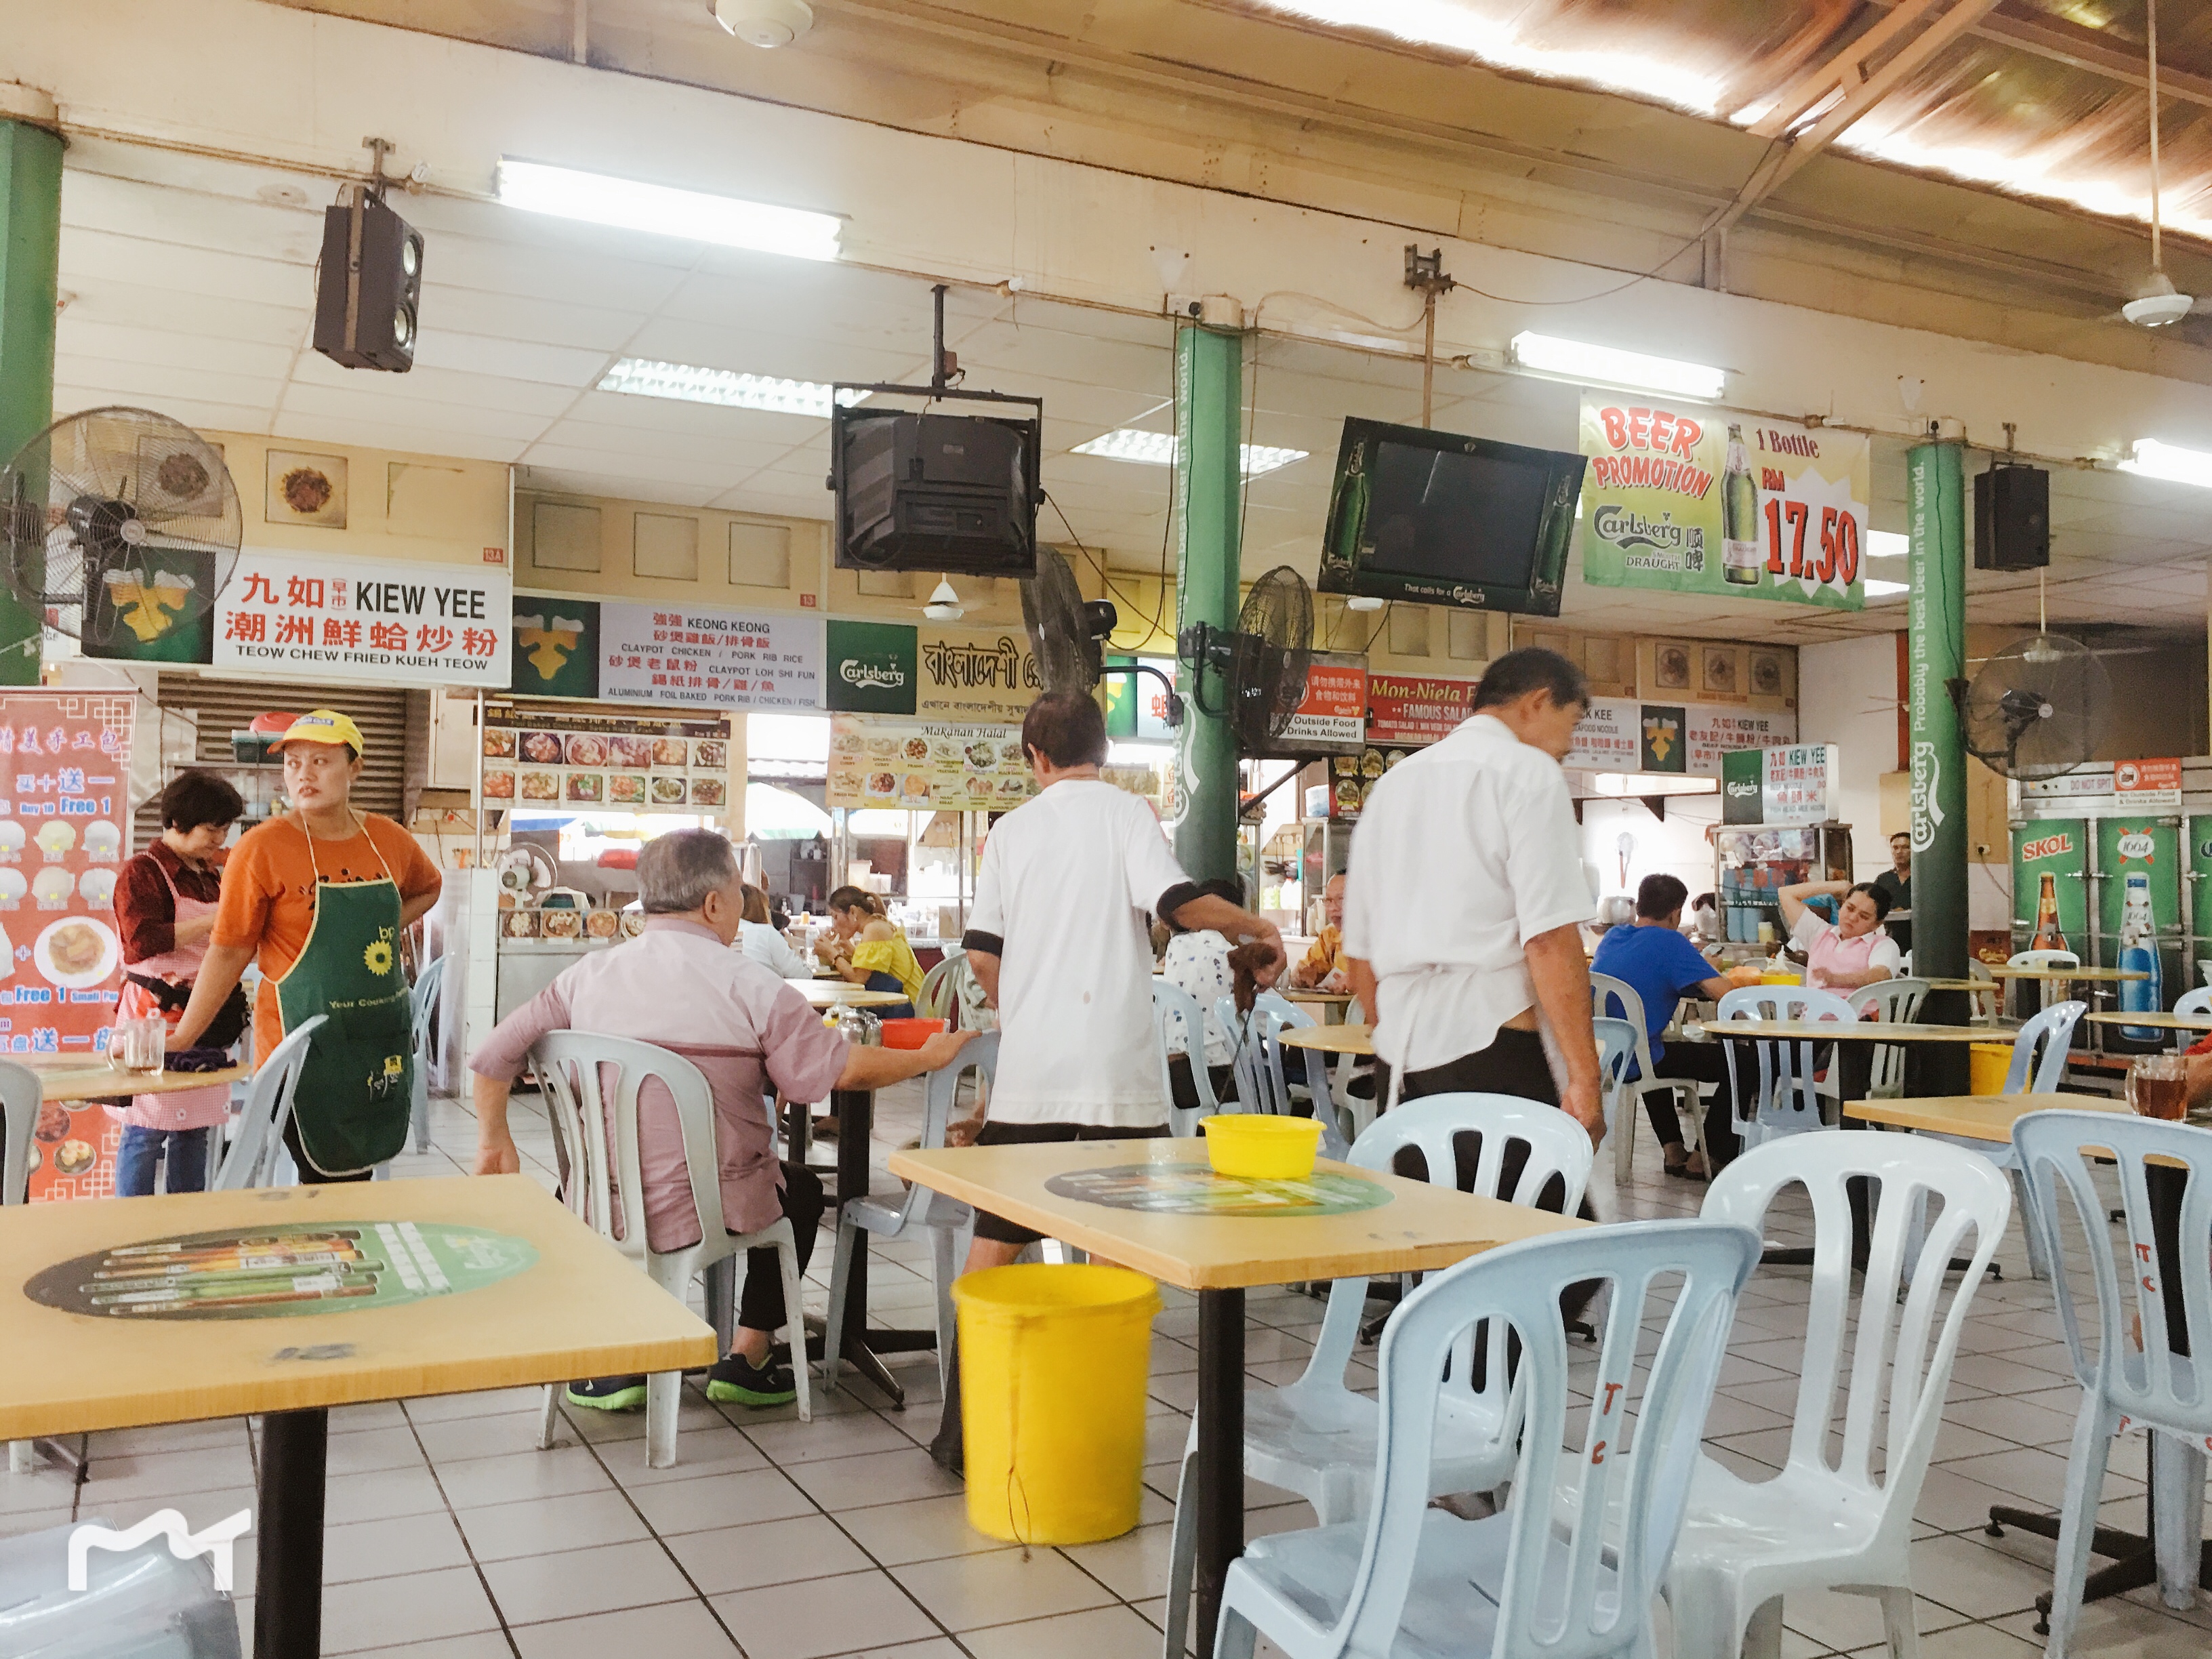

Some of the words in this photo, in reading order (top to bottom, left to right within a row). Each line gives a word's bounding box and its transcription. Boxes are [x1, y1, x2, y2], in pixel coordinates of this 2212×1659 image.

[1179, 346, 1189, 405] world.
[1179, 410, 1188, 441] the
[1601, 407, 1704, 461] BEER
[1179, 445, 1187, 462] in
[1757, 428, 1766, 451] 1
[1768, 430, 1820, 459] Bottle
[1178, 468, 1187, 510] beer
[1593, 455, 1713, 500] PROMOTION
[1761, 466, 1785, 491] RM
[1912, 462, 1925, 509] world.
[1594, 505, 1681, 549] Carlsberg
[1912, 512, 1925, 538] the
[1765, 497, 1858, 586] 17.50
[1912, 541, 1925, 556] in
[484, 549, 503, 562] 13A
[1626, 556, 1680, 571] DRAUGHT
[1912, 560, 1925, 593] beer
[241, 572, 325, 609] 九如
[356, 581, 426, 615] KIEW
[434, 586, 486, 619] YEE
[802, 595, 814, 607] 13
[1405, 583, 1419, 594] That
[1420, 586, 1435, 595] calls
[1437, 587, 1445, 596] for
[1453, 586, 1485, 604] Carlsberg
[688, 617, 728, 631] KEONG
[731, 621, 770, 634] KEONG
[1913, 597, 1925, 630] best
[236, 644, 285, 659] TEOW
[290, 648, 338, 663] CHEW
[344, 651, 391, 665] FRIED
[395, 655, 438, 668] KUEH
[445, 658, 489, 670] TEOW
[621, 643, 663, 654] CLAYPOT
[672, 646, 711, 657] CHICKEN
[732, 651, 756, 660] PORK
[763, 653, 777, 661] RIB
[783, 654, 803, 663] RICE
[1913, 634, 1925, 659] the
[709, 665, 750, 676] CLAYPOT
[756, 668, 773, 678] LOH
[779, 669, 792, 678] SHI
[798, 670, 815, 680] FUN
[840, 657, 905, 688] Carlsberg
[922, 636, 1019, 689] বাংলাদেশী
[608, 687, 653, 698] ALUMINIUM
[660, 690, 678, 699] FOIL
[680, 691, 707, 701] BAKED
[714, 693, 736, 702] PORK
[737, 695, 750, 703] RIB
[759, 695, 792, 705] CHICKEN
[799, 697, 815, 707] FISH
[1913, 663, 1929, 732] Probably
[1294, 716, 1330, 726] Outside
[1333, 718, 1356, 728] Food
[1403, 703, 1442, 720] FAMOUS
[1595, 709, 1612, 721] KEE
[921, 726, 974, 739] Makanan
[977, 726, 1007, 739] Halal
[1287, 726, 1317, 737] Drinks
[1320, 729, 1357, 739] Allowed
[1574, 723, 1596, 733] EAFOOD
[1597, 725, 1618, 734] NOODLE
[1738, 719, 1755, 731] KIEW
[1756, 720, 1769, 731] YEE
[1789, 749, 1807, 766] KIEW
[1811, 747, 1825, 764] YEE
[1727, 781, 1758, 798] Carlsberg
[1910, 741, 1945, 853] Carlsberg
[20, 803, 40, 815] Buy
[43, 803, 54, 814] 10
[60, 796, 96, 815] Free
[102, 797, 110, 814] 1
[2023, 834, 2072, 861] SKOL
[16, 985, 51, 1004] Free
[57, 985, 66, 1003] 1
